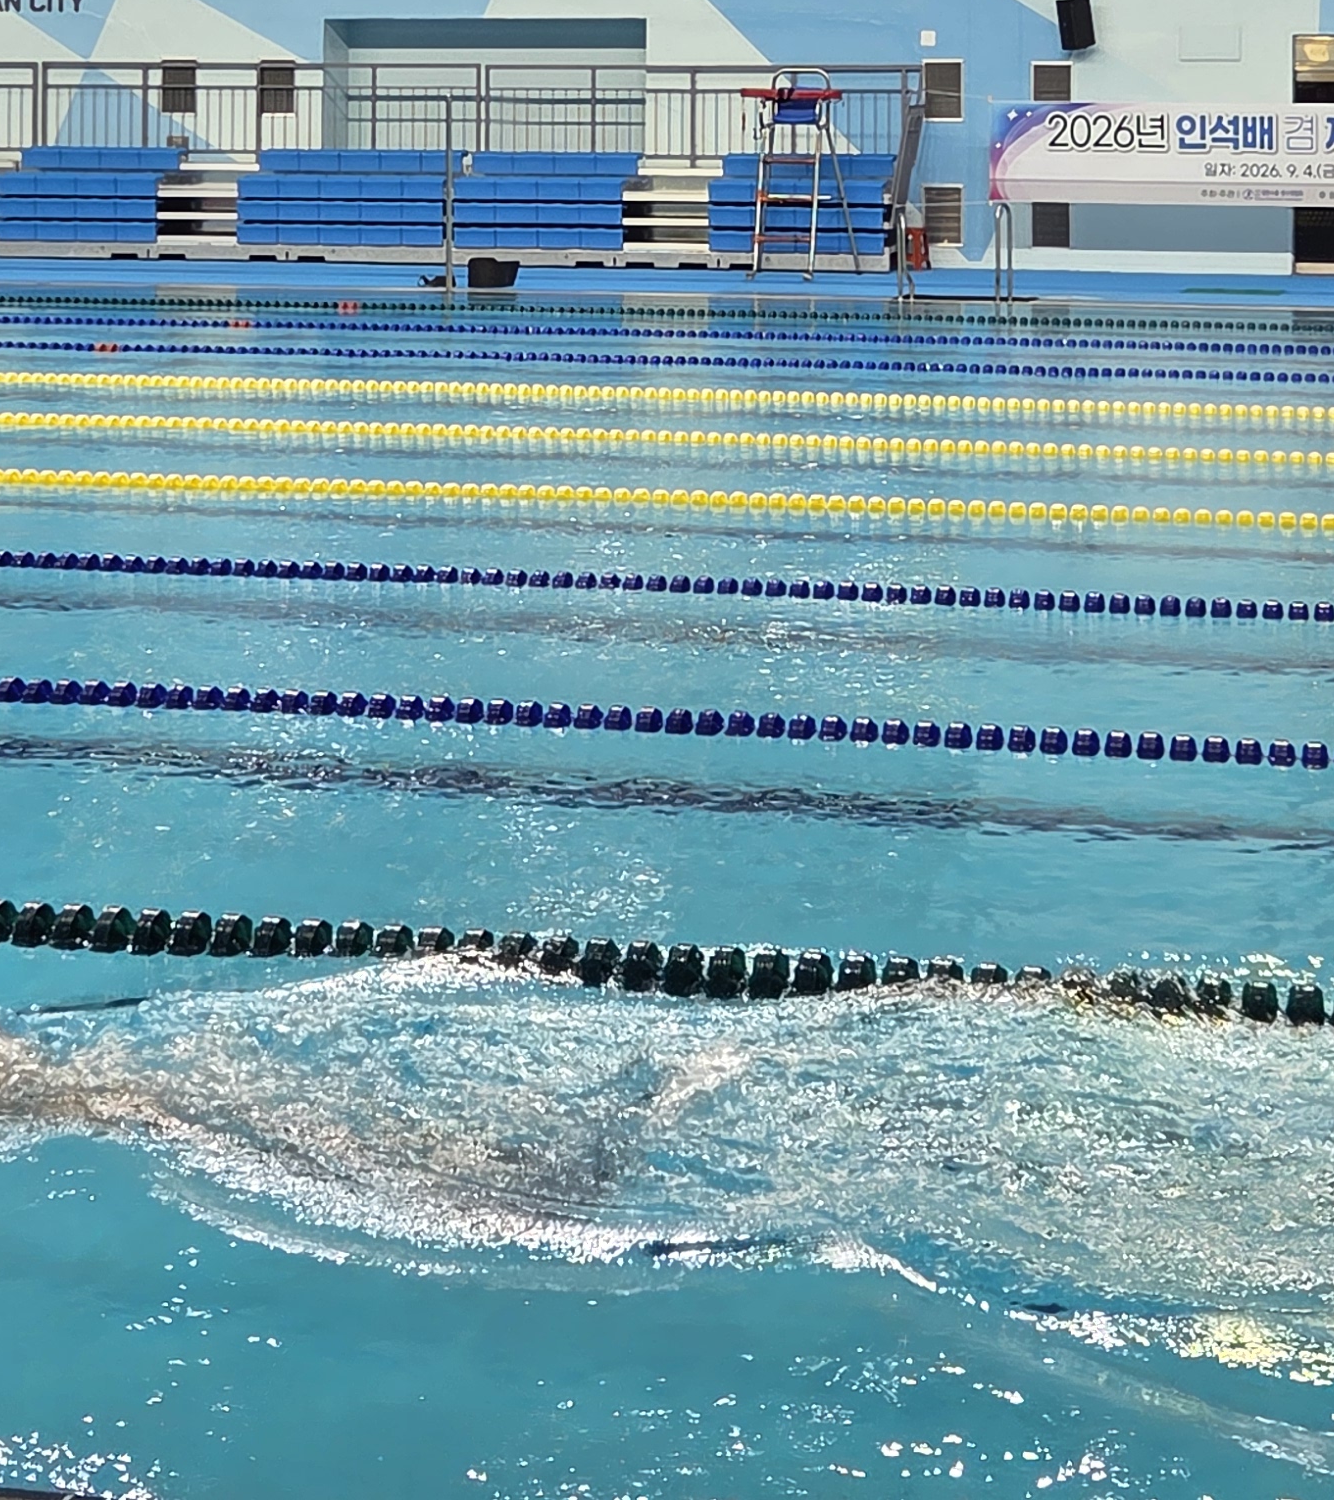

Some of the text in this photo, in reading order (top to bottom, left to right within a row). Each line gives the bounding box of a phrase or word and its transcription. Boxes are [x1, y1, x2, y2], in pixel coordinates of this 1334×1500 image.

[1046, 113, 1166, 149] 2026년
[1175, 114, 1274, 150] 인석배
[1283, 115, 1314, 150] 겸
[1204, 162, 1236, 177] 일자:
[1240, 163, 1282, 178] 2026.
[1286, 164, 1299, 178] 9.
